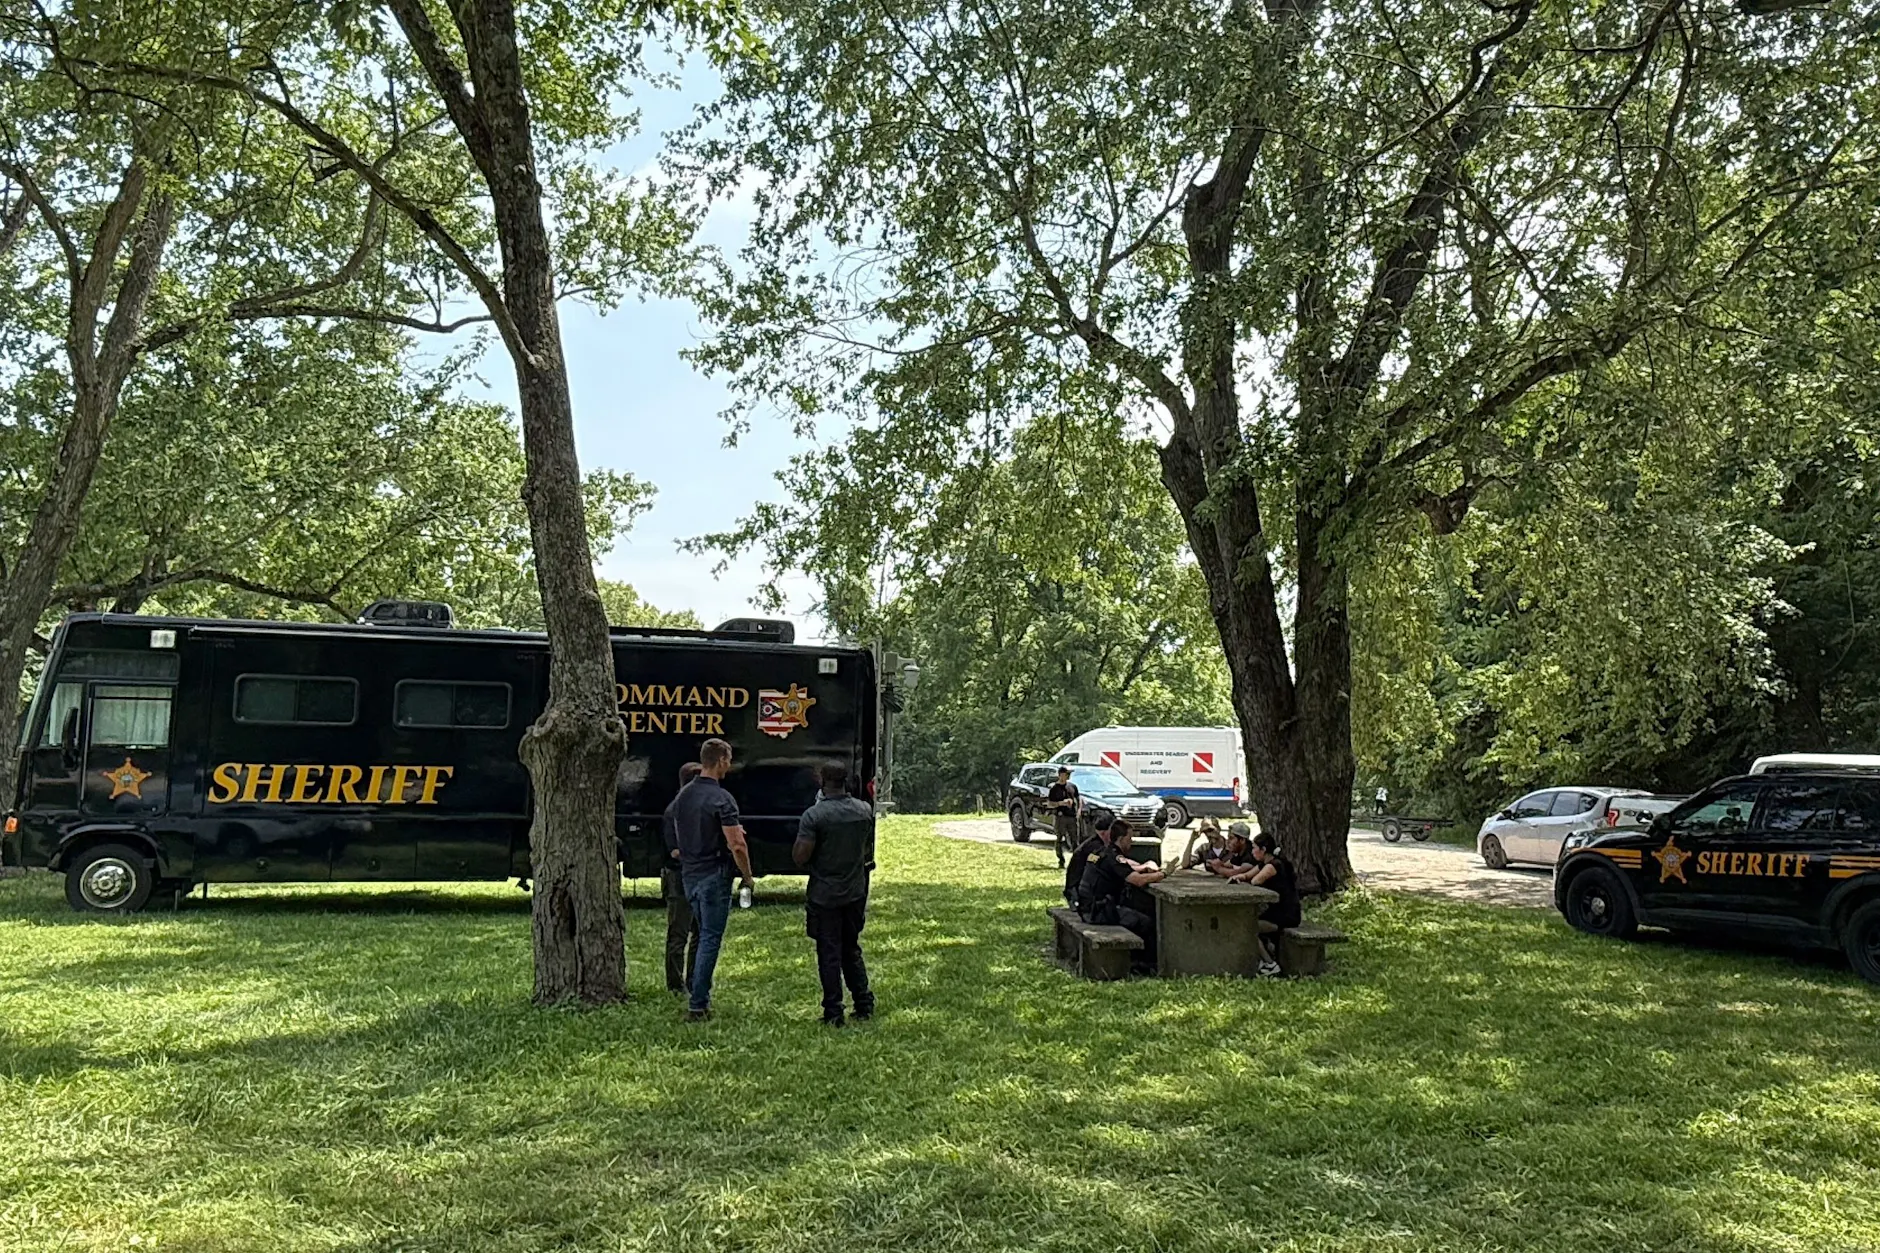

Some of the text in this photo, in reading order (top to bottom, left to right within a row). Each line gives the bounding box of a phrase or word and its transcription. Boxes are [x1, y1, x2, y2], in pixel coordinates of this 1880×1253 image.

[616, 684, 749, 708] OMMAND
[208, 762, 454, 805] SHERIFF
[1696, 851, 1811, 877] SHERIFF
